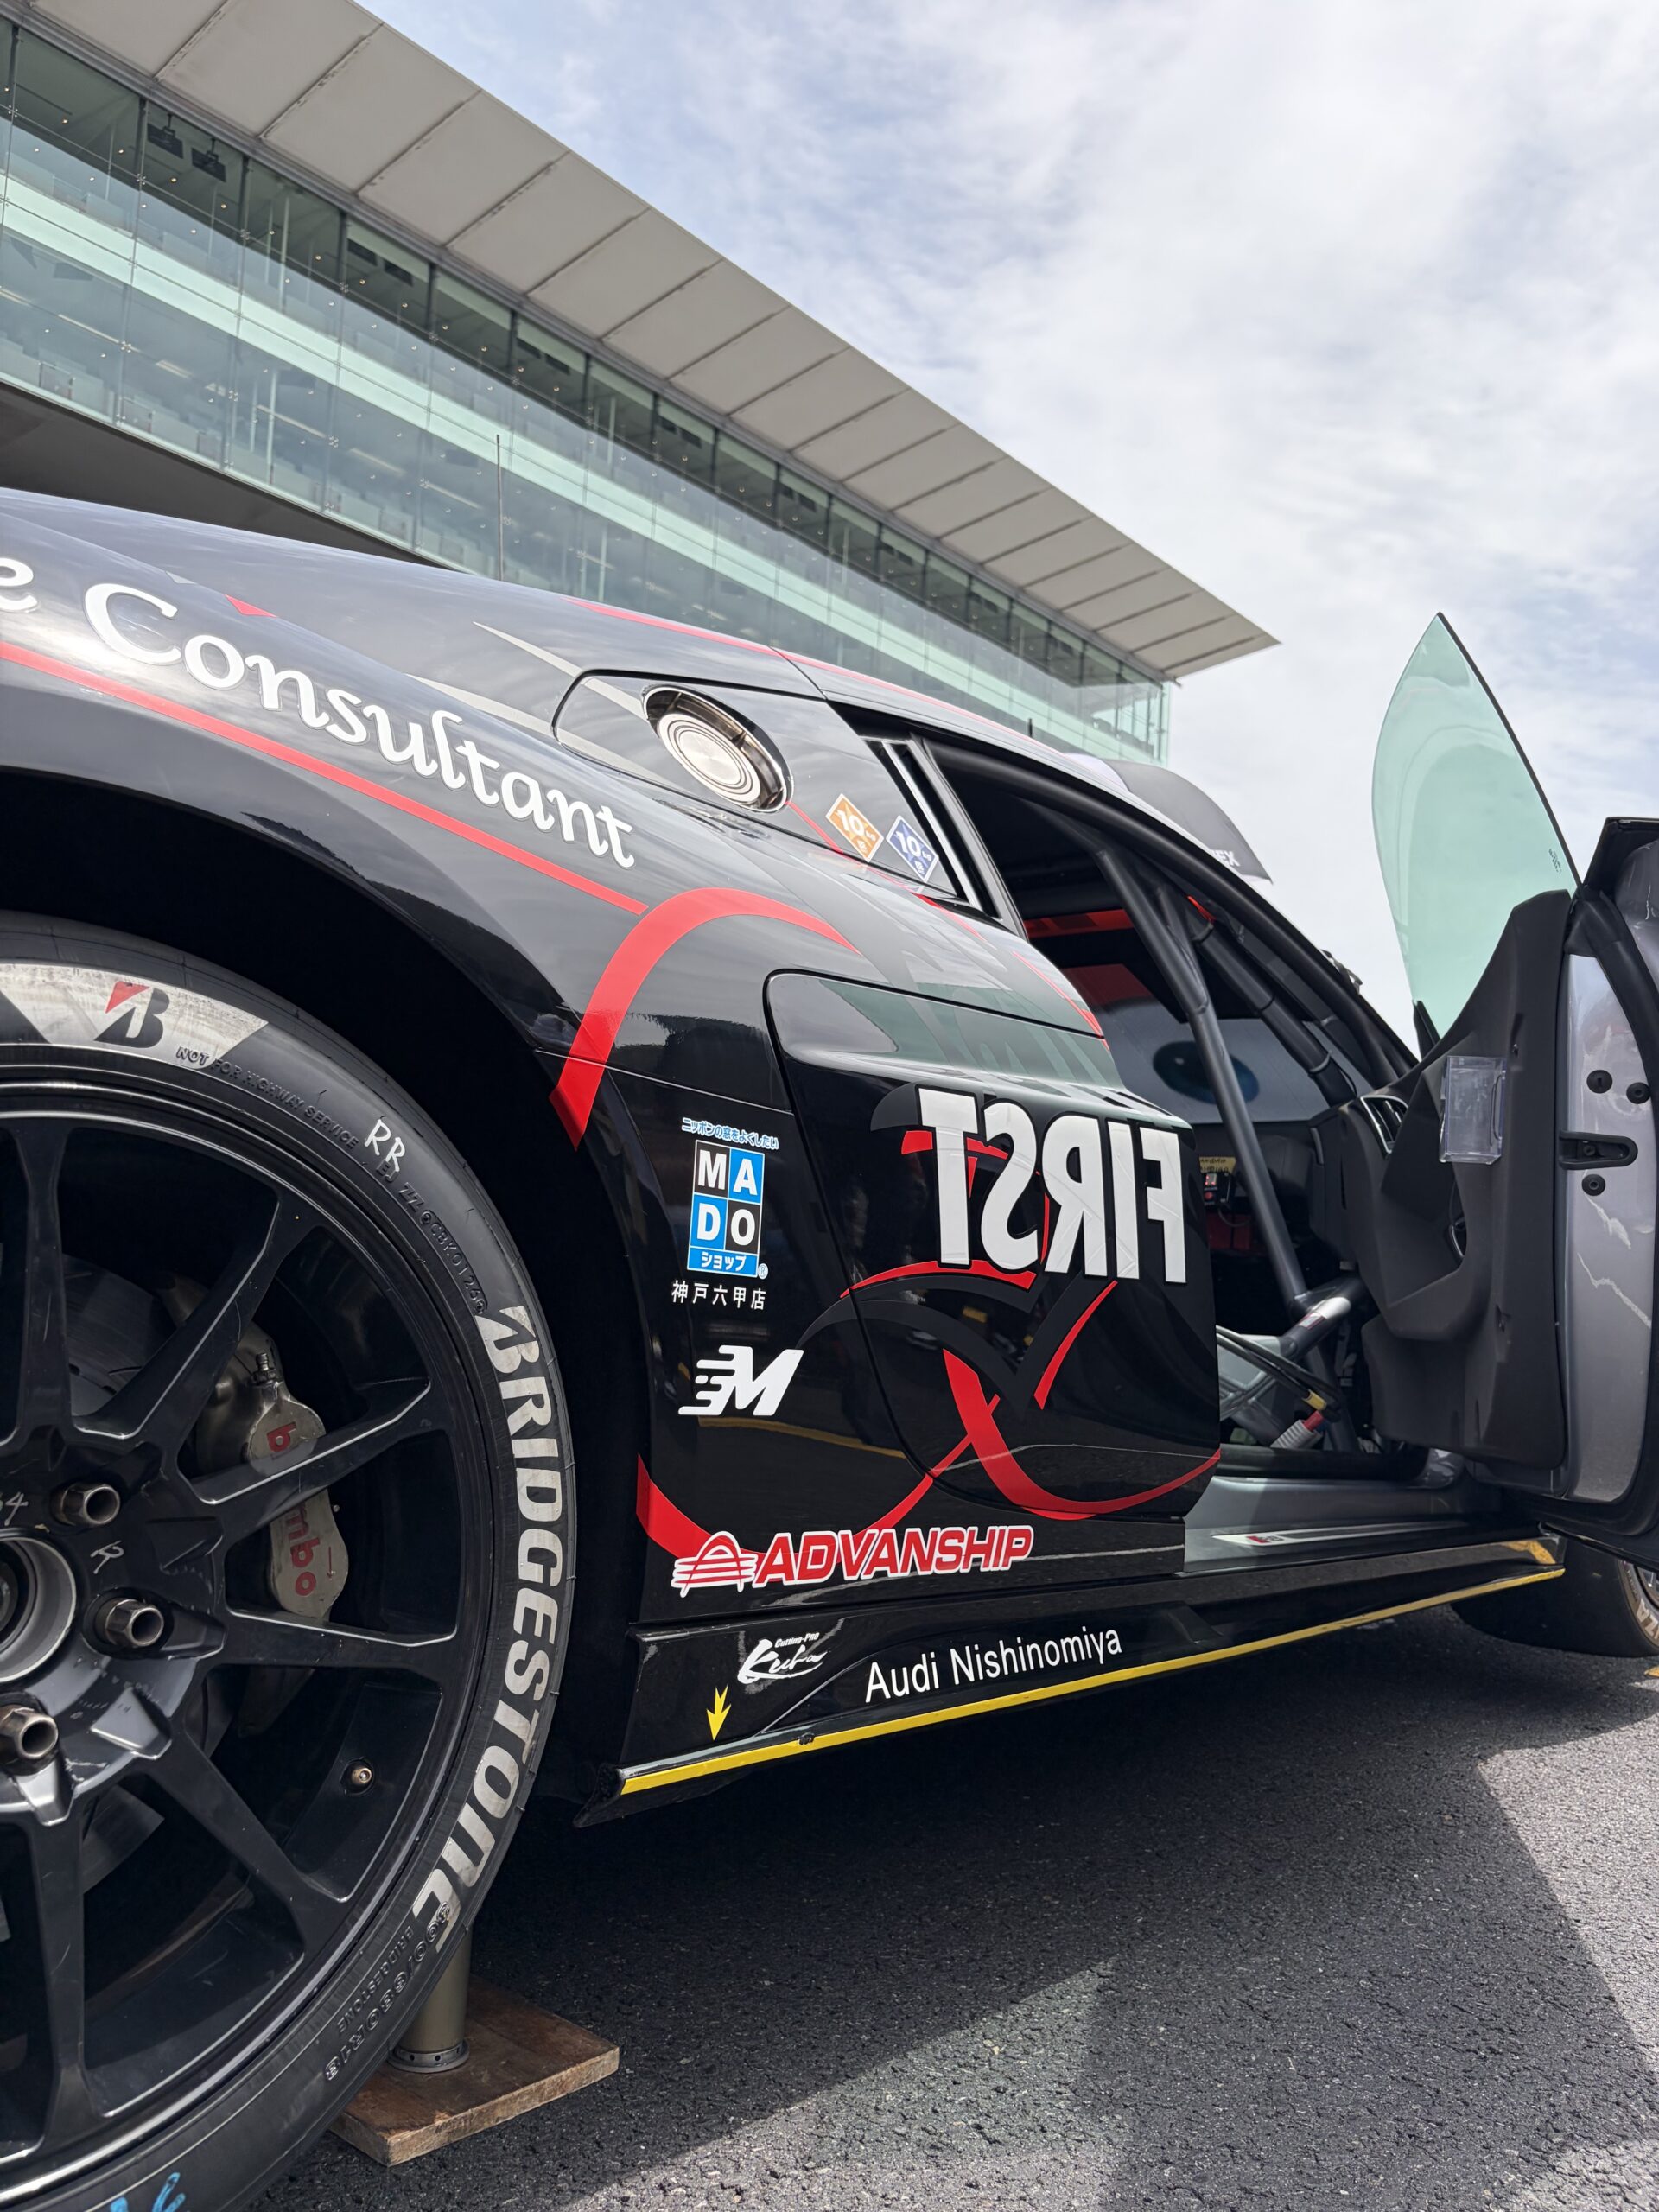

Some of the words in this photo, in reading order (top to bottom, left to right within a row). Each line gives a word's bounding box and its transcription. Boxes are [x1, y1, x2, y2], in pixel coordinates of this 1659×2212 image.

[84, 583, 634, 868] Consultant
[176, 1046, 209, 1066] NOT
[211, 1058, 241, 1079] FOR
[243, 1071, 306, 1111] HIGHWAY
[305, 1105, 359, 1148] SERVICE
[364, 1118, 406, 1173] RR
[681, 1117, 779, 1150] ニッポンの窓をよくしたい
[671, 1280, 766, 1311] 神戸六甲店
[701, 1251, 747, 1272] ショップ
[752, 1525, 1034, 1589] ADVANSHIP
[412, 1306, 564, 1953] BRIDGESTONE
[865, 1651, 939, 1704] Audi
[949, 1625, 1123, 1687] Nishinomiya
[337, 1925, 414, 2034] BRIDGESTONE
